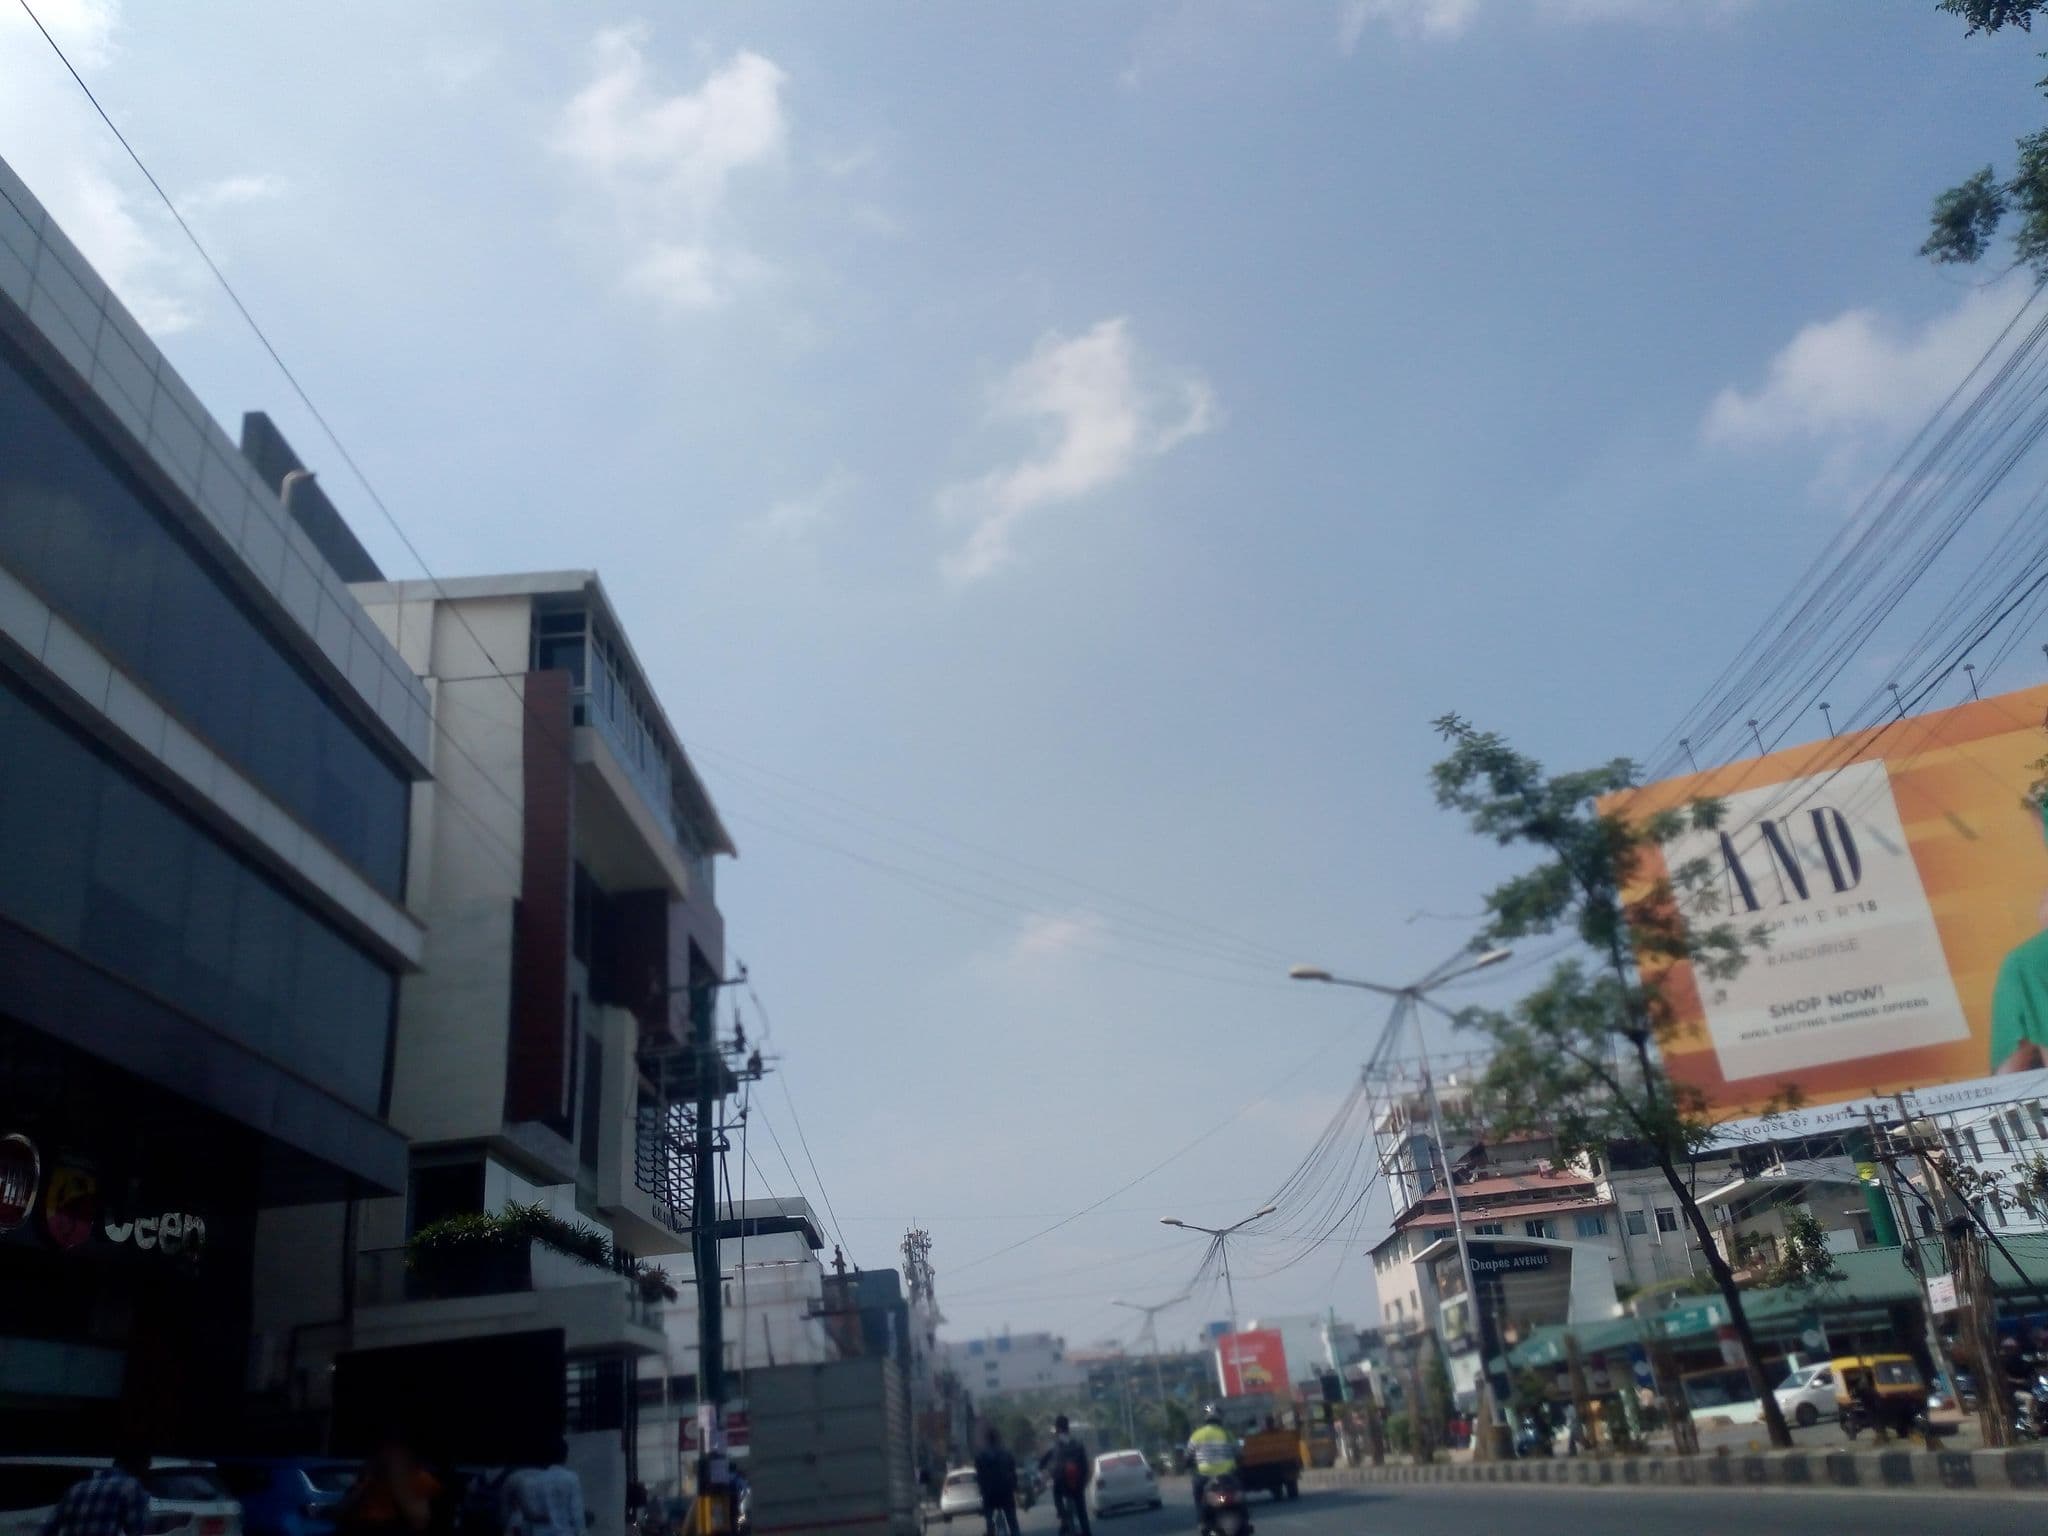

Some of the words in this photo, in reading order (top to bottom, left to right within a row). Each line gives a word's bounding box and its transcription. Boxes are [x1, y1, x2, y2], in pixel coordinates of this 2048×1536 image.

[1719, 806, 1862, 917] AND
[1768, 996, 1822, 1019] SHOP
[1828, 984, 1886, 1008] NOW!
[1742, 1120, 1790, 1136] HOUSE
[1792, 1117, 1809, 1127] OF
[1513, 1255, 1549, 1267] AVENUE
